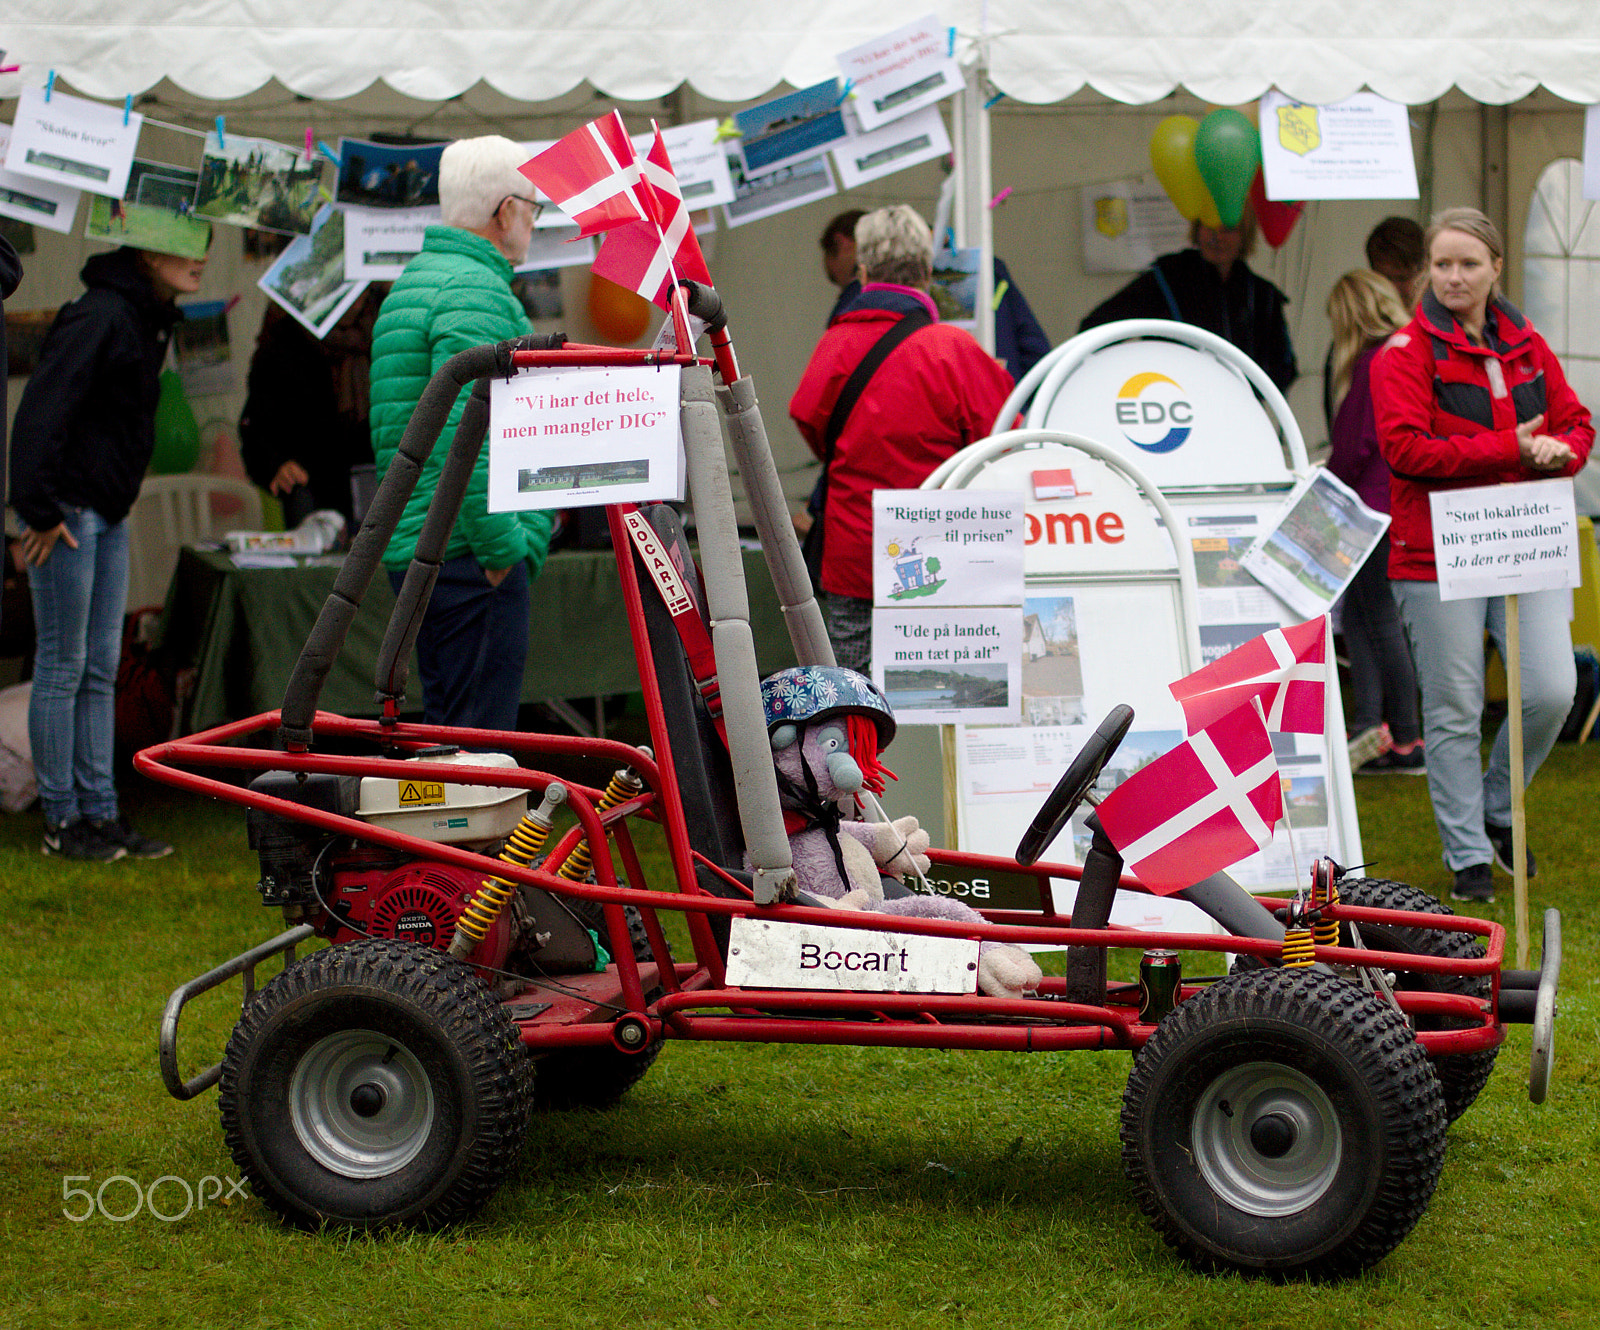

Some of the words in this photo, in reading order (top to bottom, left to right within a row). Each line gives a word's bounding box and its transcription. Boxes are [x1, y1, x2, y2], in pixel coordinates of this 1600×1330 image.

[515, 395, 544, 410] ”Vi
[550, 395, 579, 408] har
[584, 391, 611, 406] det
[616, 387, 655, 404] hele,
[1115, 401, 1194, 425] EDC
[502, 425, 537, 439] men
[543, 416, 614, 437] mangler
[619, 411, 667, 430] DIG”
[886, 506, 942, 523] ”Rigtigt
[945, 506, 978, 523] gode
[981, 506, 1012, 520] huse
[1484, 502, 1550, 521] lokalrådet
[945, 530, 959, 543] til
[963, 529, 1013, 545] prisen”
[1024, 511, 1125, 545] ome
[1441, 532, 1467, 546] bliv
[1470, 528, 1508, 547] gratis
[1511, 521, 1570, 539] medlem”
[628, 517, 677, 597] BOCART
[1471, 554, 1494, 567] den
[1497, 553, 1511, 564] er
[1512, 548, 1537, 566] god
[1539, 545, 1569, 560] nok!
[894, 624, 929, 638] ”Ude
[933, 623, 950, 641] på
[954, 624, 1000, 639] landet,
[895, 650, 923, 661] men
[928, 649, 949, 660] tæt
[953, 646, 970, 663] på
[974, 645, 1000, 660] alt”
[397, 921, 433, 930] HONDA
[800, 943, 908, 972] Bocart
